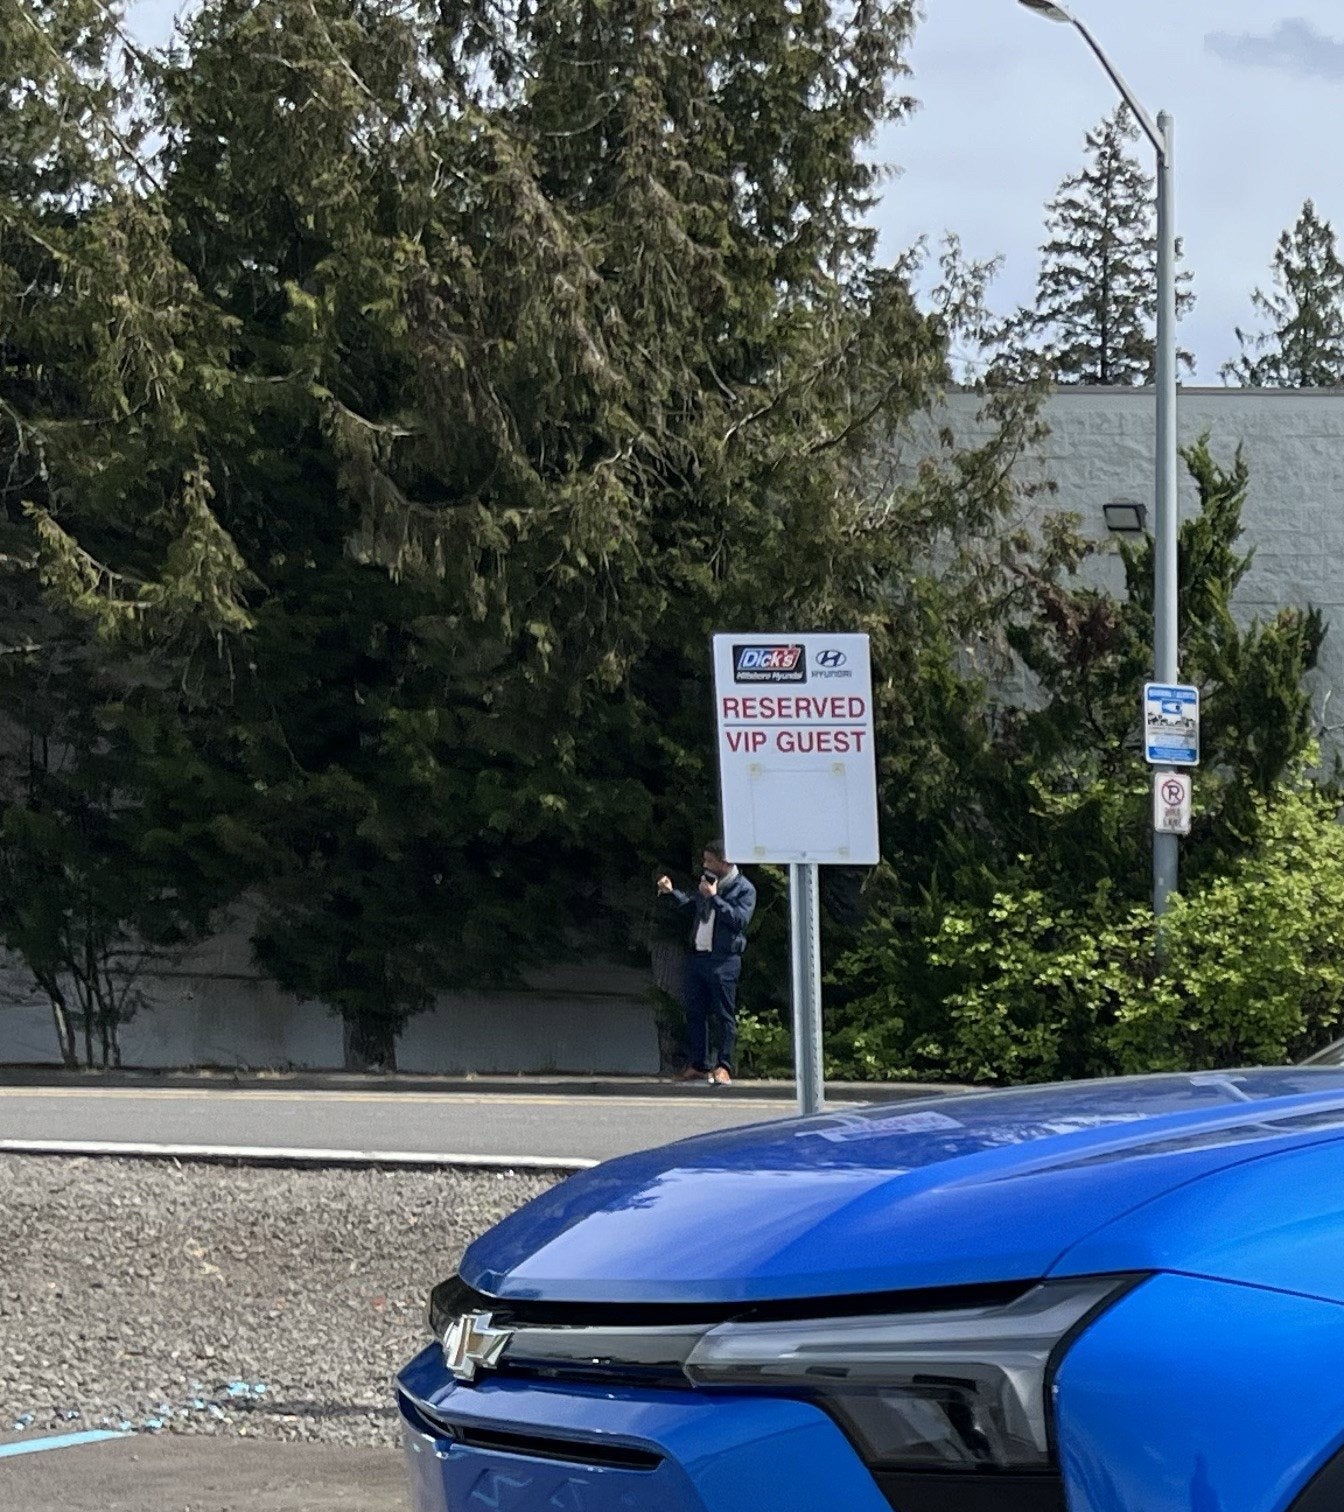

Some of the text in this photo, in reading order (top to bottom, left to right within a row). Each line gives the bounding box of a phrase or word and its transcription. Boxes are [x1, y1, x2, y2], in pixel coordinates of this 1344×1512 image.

[723, 697, 865, 719] RESERVED
[726, 731, 866, 753] VIP GUEST
